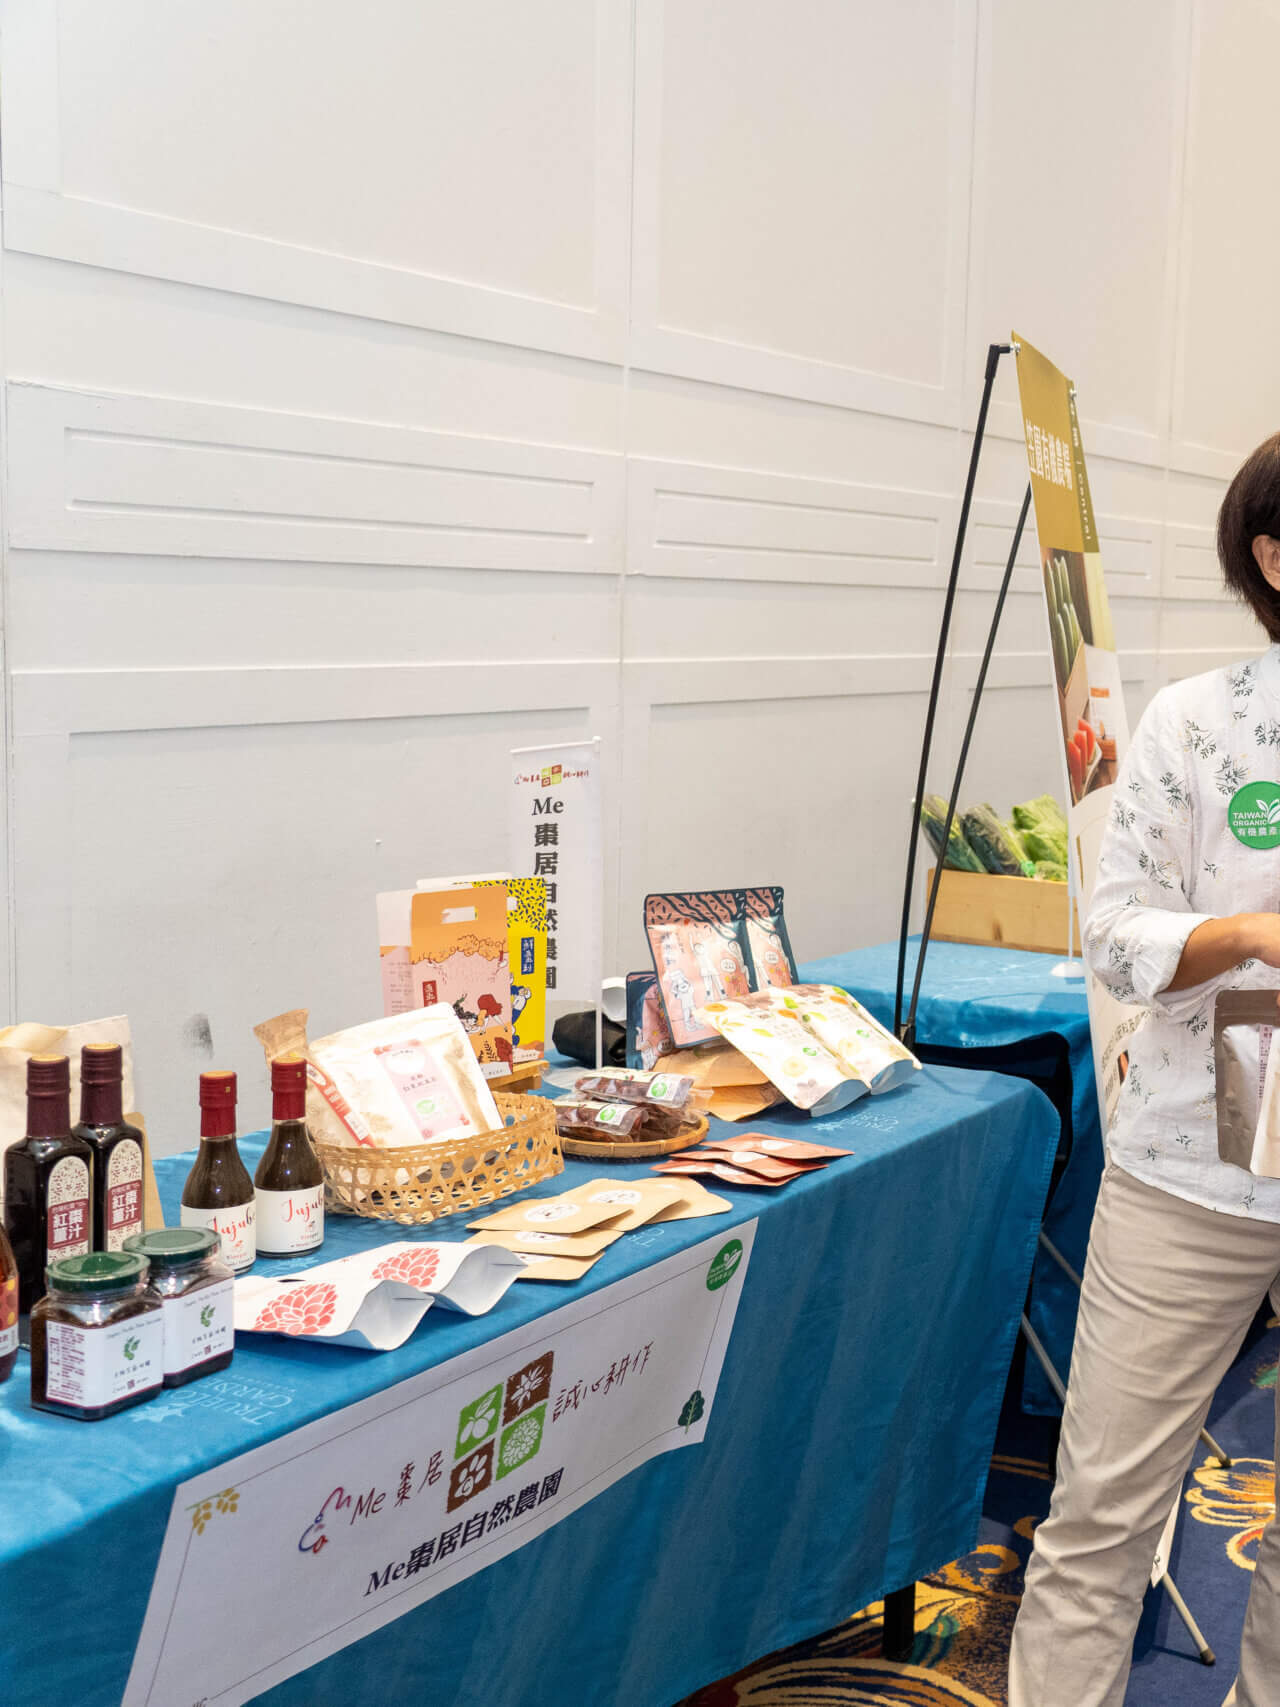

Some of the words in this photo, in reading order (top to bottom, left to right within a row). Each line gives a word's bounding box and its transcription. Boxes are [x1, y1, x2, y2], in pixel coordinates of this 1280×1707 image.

[531, 796, 564, 816] Me
[1232, 811, 1268, 820] TAIWAN
[351, 1487, 387, 1526] Me
[364, 1467, 565, 1597] Me棗居自然農園
